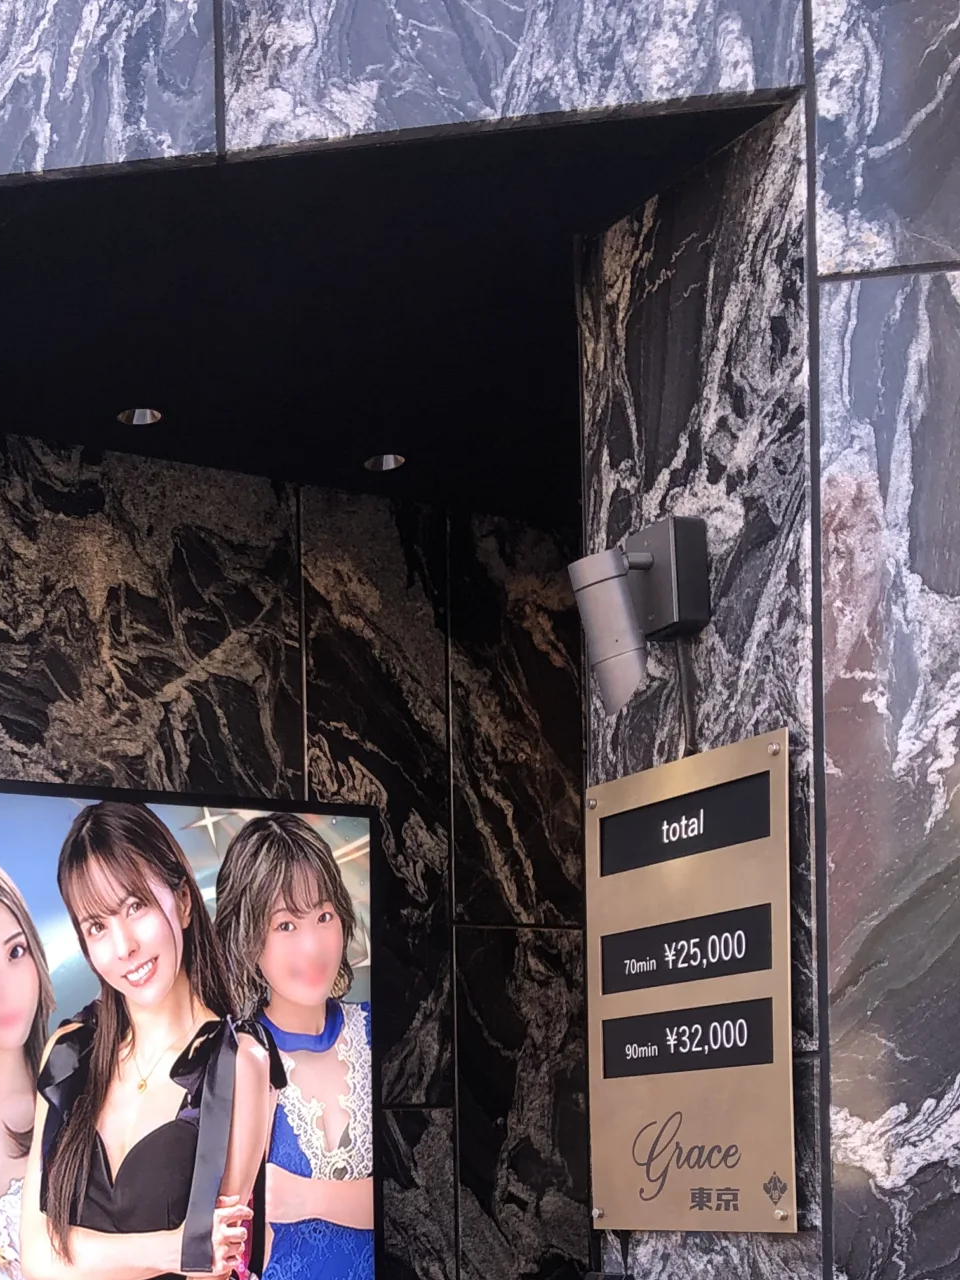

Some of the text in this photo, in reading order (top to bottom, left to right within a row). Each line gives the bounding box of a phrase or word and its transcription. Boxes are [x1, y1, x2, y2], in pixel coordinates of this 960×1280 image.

[661, 809, 705, 844] total
[623, 929, 747, 976] 70min ¥25,000
[625, 1018, 749, 1061] 90min ¥32,000
[632, 1111, 742, 1202] Grace
[689, 1187, 741, 1213] 東京
